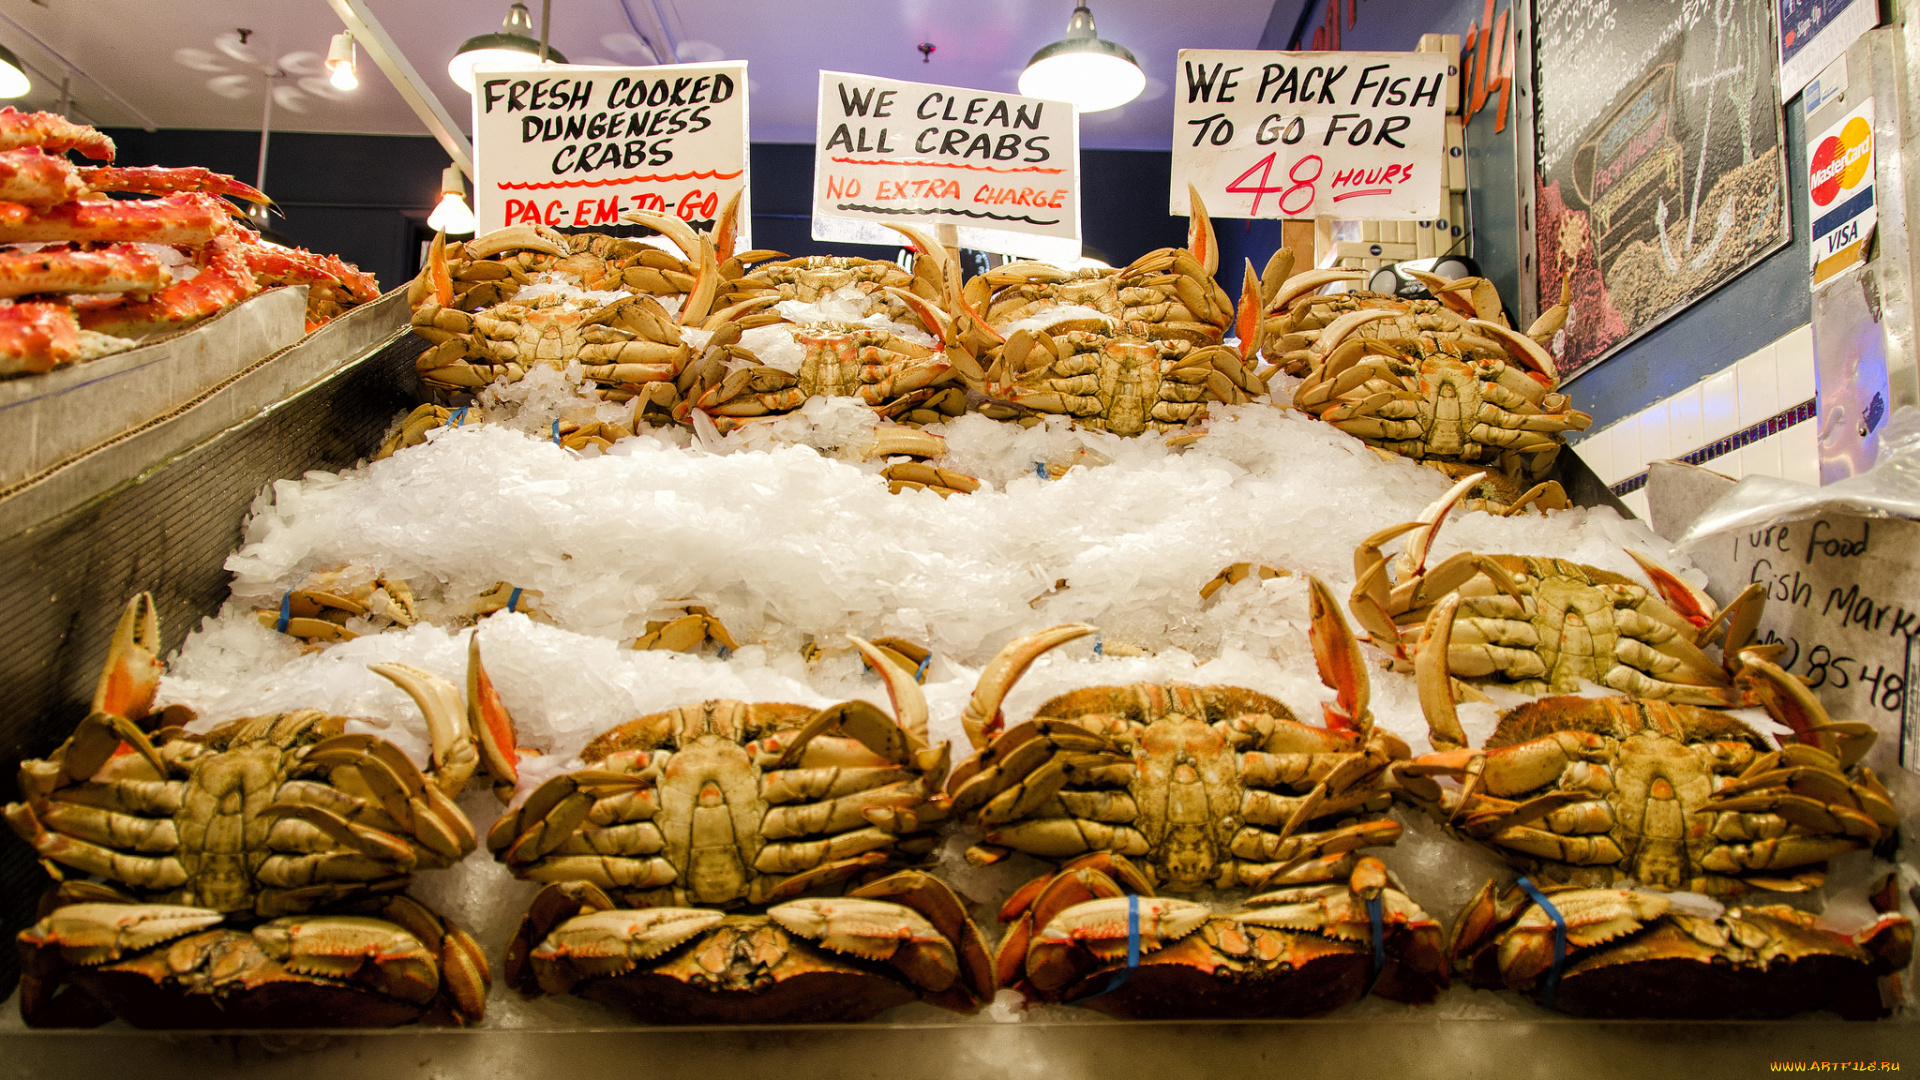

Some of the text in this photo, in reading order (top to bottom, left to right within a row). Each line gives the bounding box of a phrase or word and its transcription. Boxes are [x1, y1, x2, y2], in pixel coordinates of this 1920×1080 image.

[483, 73, 734, 113] FRESH COOKED
[1185, 61, 1444, 107] WE PACK FISH
[521, 105, 711, 143] DUNGENESS
[838, 82, 1043, 130] WE CLEAN
[825, 123, 1050, 162] ALL CRABS
[1188, 113, 1411, 149] TO GO FOR
[551, 138, 674, 175] CRABS
[1810, 134, 1871, 191] MasterCard
[826, 174, 1069, 209] NO EXTRA CHARGE
[1225, 151, 1414, 216] 48 HOURS
[1828, 220, 1858, 253] VISA
